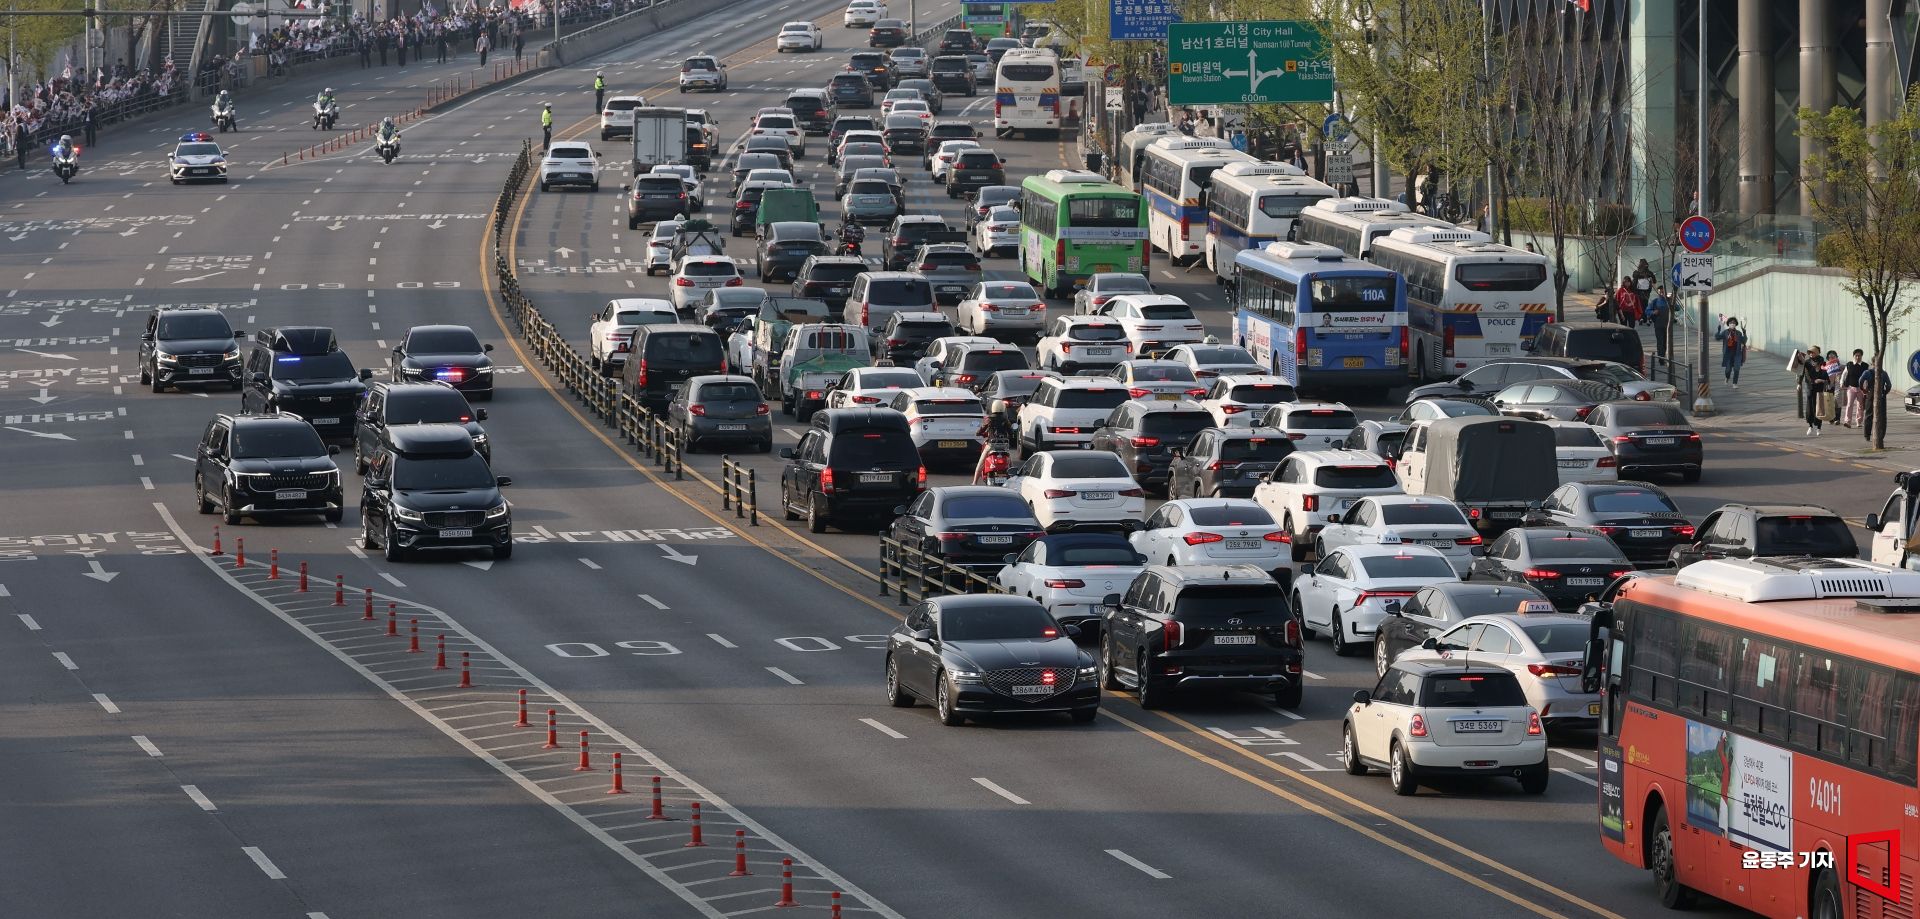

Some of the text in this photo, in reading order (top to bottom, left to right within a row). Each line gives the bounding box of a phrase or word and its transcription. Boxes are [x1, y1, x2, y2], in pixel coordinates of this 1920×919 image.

[1223, 23, 1249, 35] 시청
[1253, 27, 1293, 38] City Hall
[1181, 36, 1249, 50] 남산1호터널
[1253, 40, 1279, 49] Namsan
[1291, 39, 1312, 48] Tunnel
[1182, 61, 1222, 74] 이태원역
[1297, 60, 1332, 74] 약수역
[1203, 74, 1222, 82] Station
[1241, 94, 1268, 102] 600m
[1115, 207, 1135, 219] 6211
[1683, 257, 1713, 268] 견인지역
[1362, 289, 1386, 301] 110A
[1487, 318, 1516, 326] POLICE
[1237, 635, 1254, 644] 1073
[1034, 685, 1051, 695] 4761
[1478, 721, 1498, 730] 5369
[1743, 772, 1757, 786] KLPGA
[1809, 776, 1842, 817] 9401-1
[1743, 792, 1786, 831] 포천힐스CC
